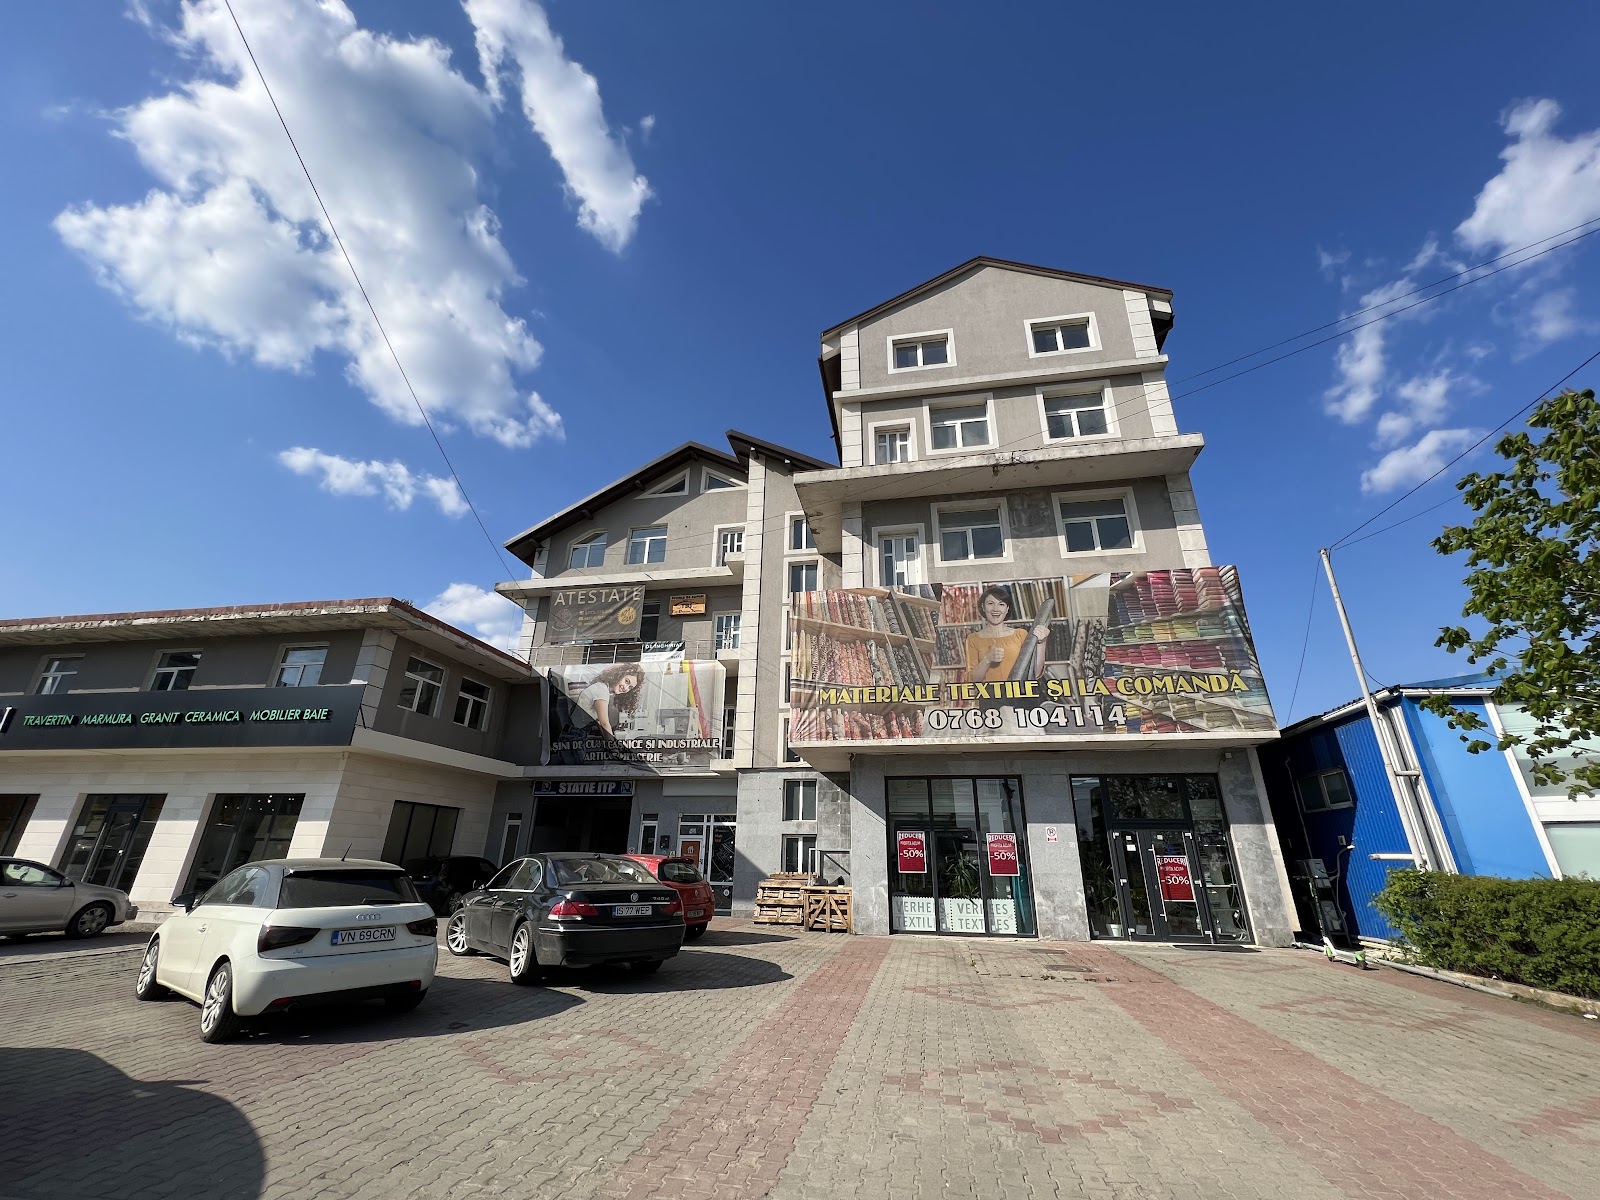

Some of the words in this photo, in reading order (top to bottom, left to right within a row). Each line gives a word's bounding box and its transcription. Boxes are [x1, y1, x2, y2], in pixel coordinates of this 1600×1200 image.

[554, 587, 641, 606] ATESTATE
[819, 684, 940, 705] MATERIALE
[946, 680, 1040, 701] TEXTILE
[1077, 678, 1111, 697] LA
[23, 715, 74, 726] TRAVERTIN
[80, 713, 132, 725] MARMURA
[140, 712, 180, 724] GRANIT
[184, 711, 240, 723] CERAMICA
[249, 709, 300, 721] MOBILIER
[302, 708, 329, 720] BAIE
[928, 708, 1003, 730] 0768
[1013, 704, 1127, 729] 104114
[658, 738, 719, 749] INDUSTRIALE
[597, 781, 616, 793] ITP
[900, 850, 924, 858] -50%
[990, 851, 1016, 860] -50%
[1161, 875, 1189, 885] -50%
[616, 907, 624, 915] IS
[340, 931, 356, 942] VN
